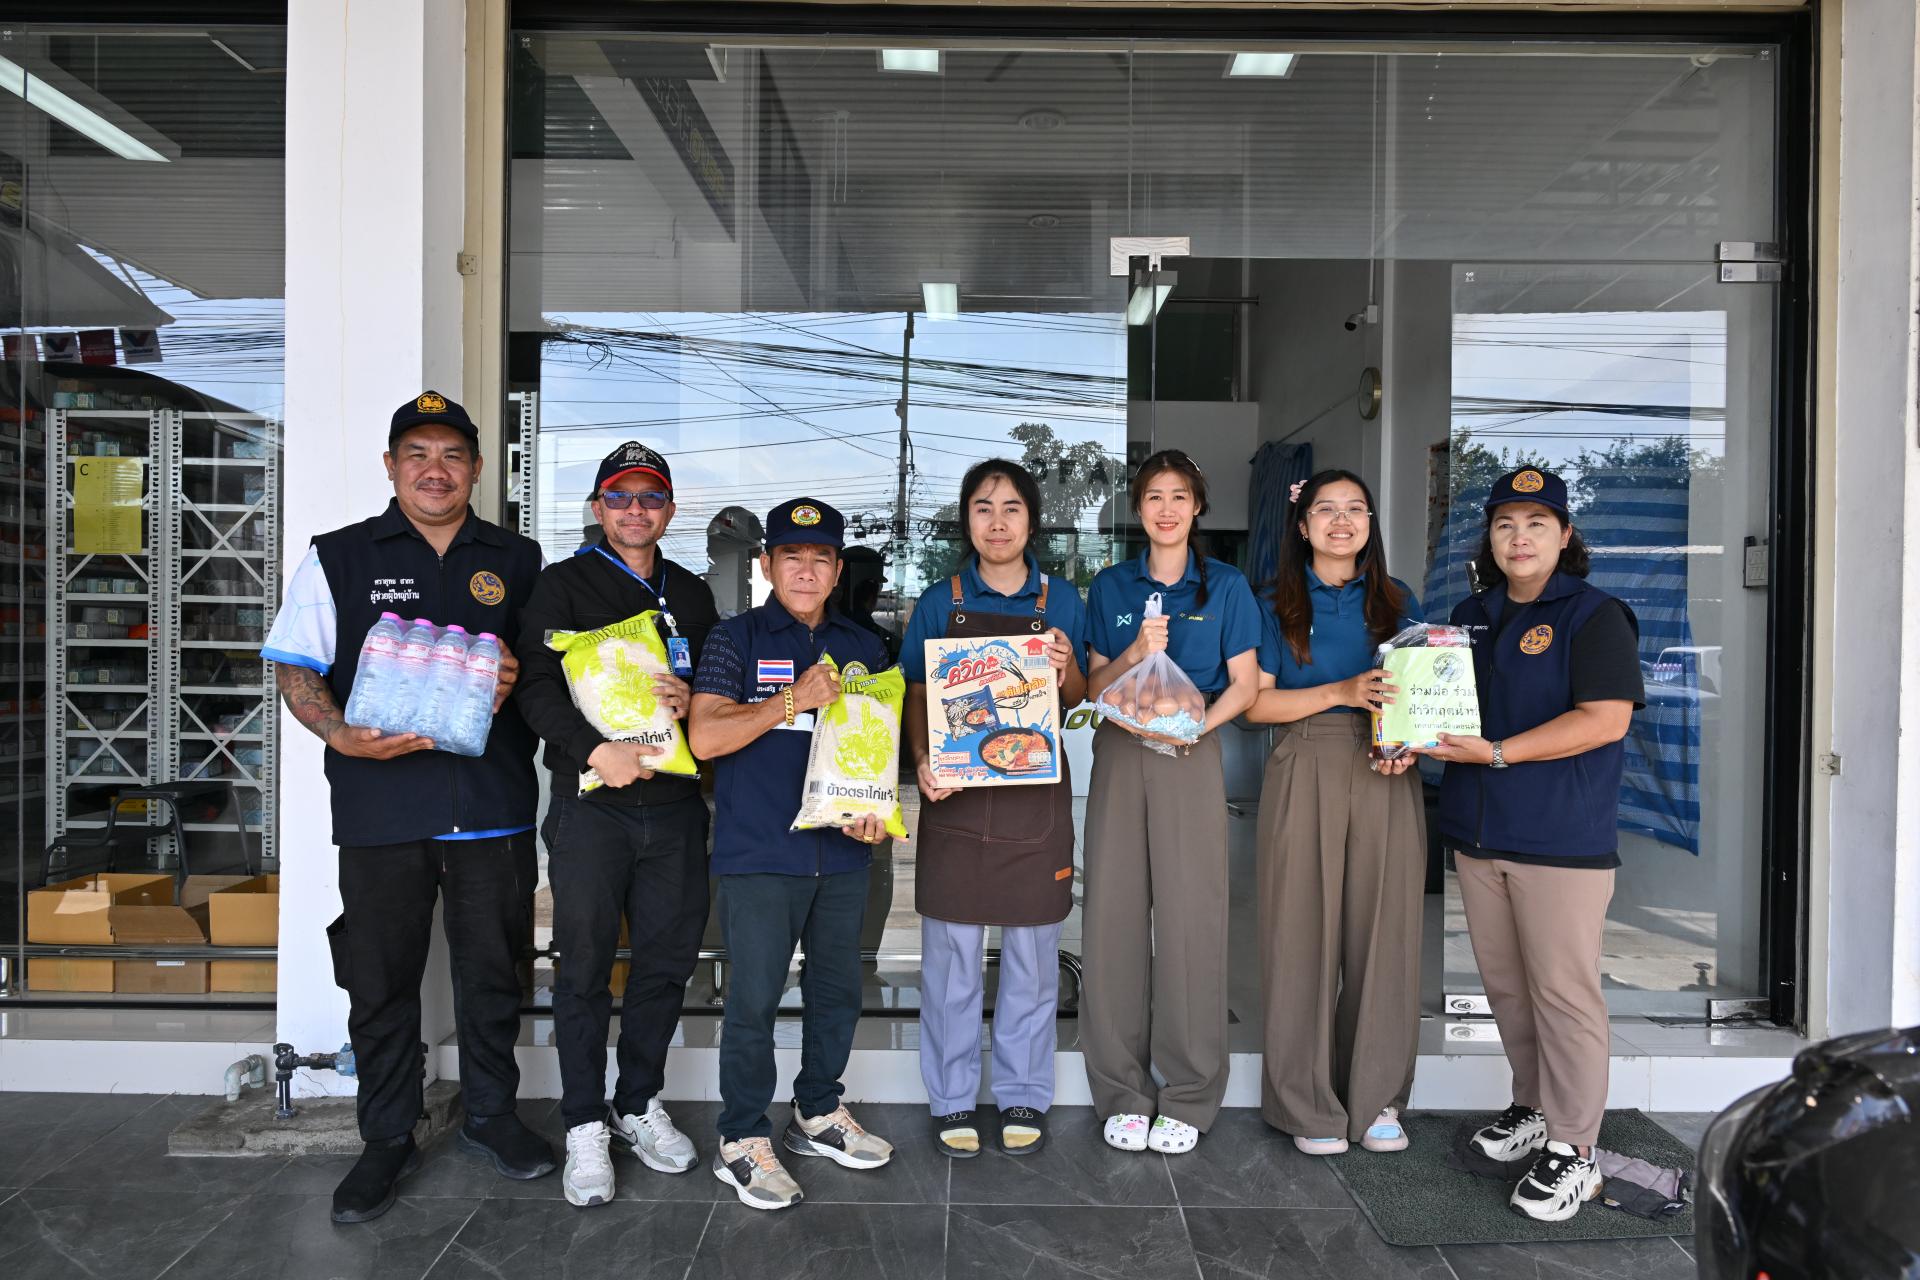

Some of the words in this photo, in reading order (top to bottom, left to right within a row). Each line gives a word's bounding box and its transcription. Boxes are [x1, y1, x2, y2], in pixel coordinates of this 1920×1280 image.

[80, 464, 88, 476] C
[370, 589, 420, 604] ผู้ช่วยผู้ใหญ่บ้าน
[947, 657, 986, 684] ควิก
[1409, 683, 1449, 696] ร่วมมือ
[827, 783, 894, 802] ข้าวตราไก่แจ้
